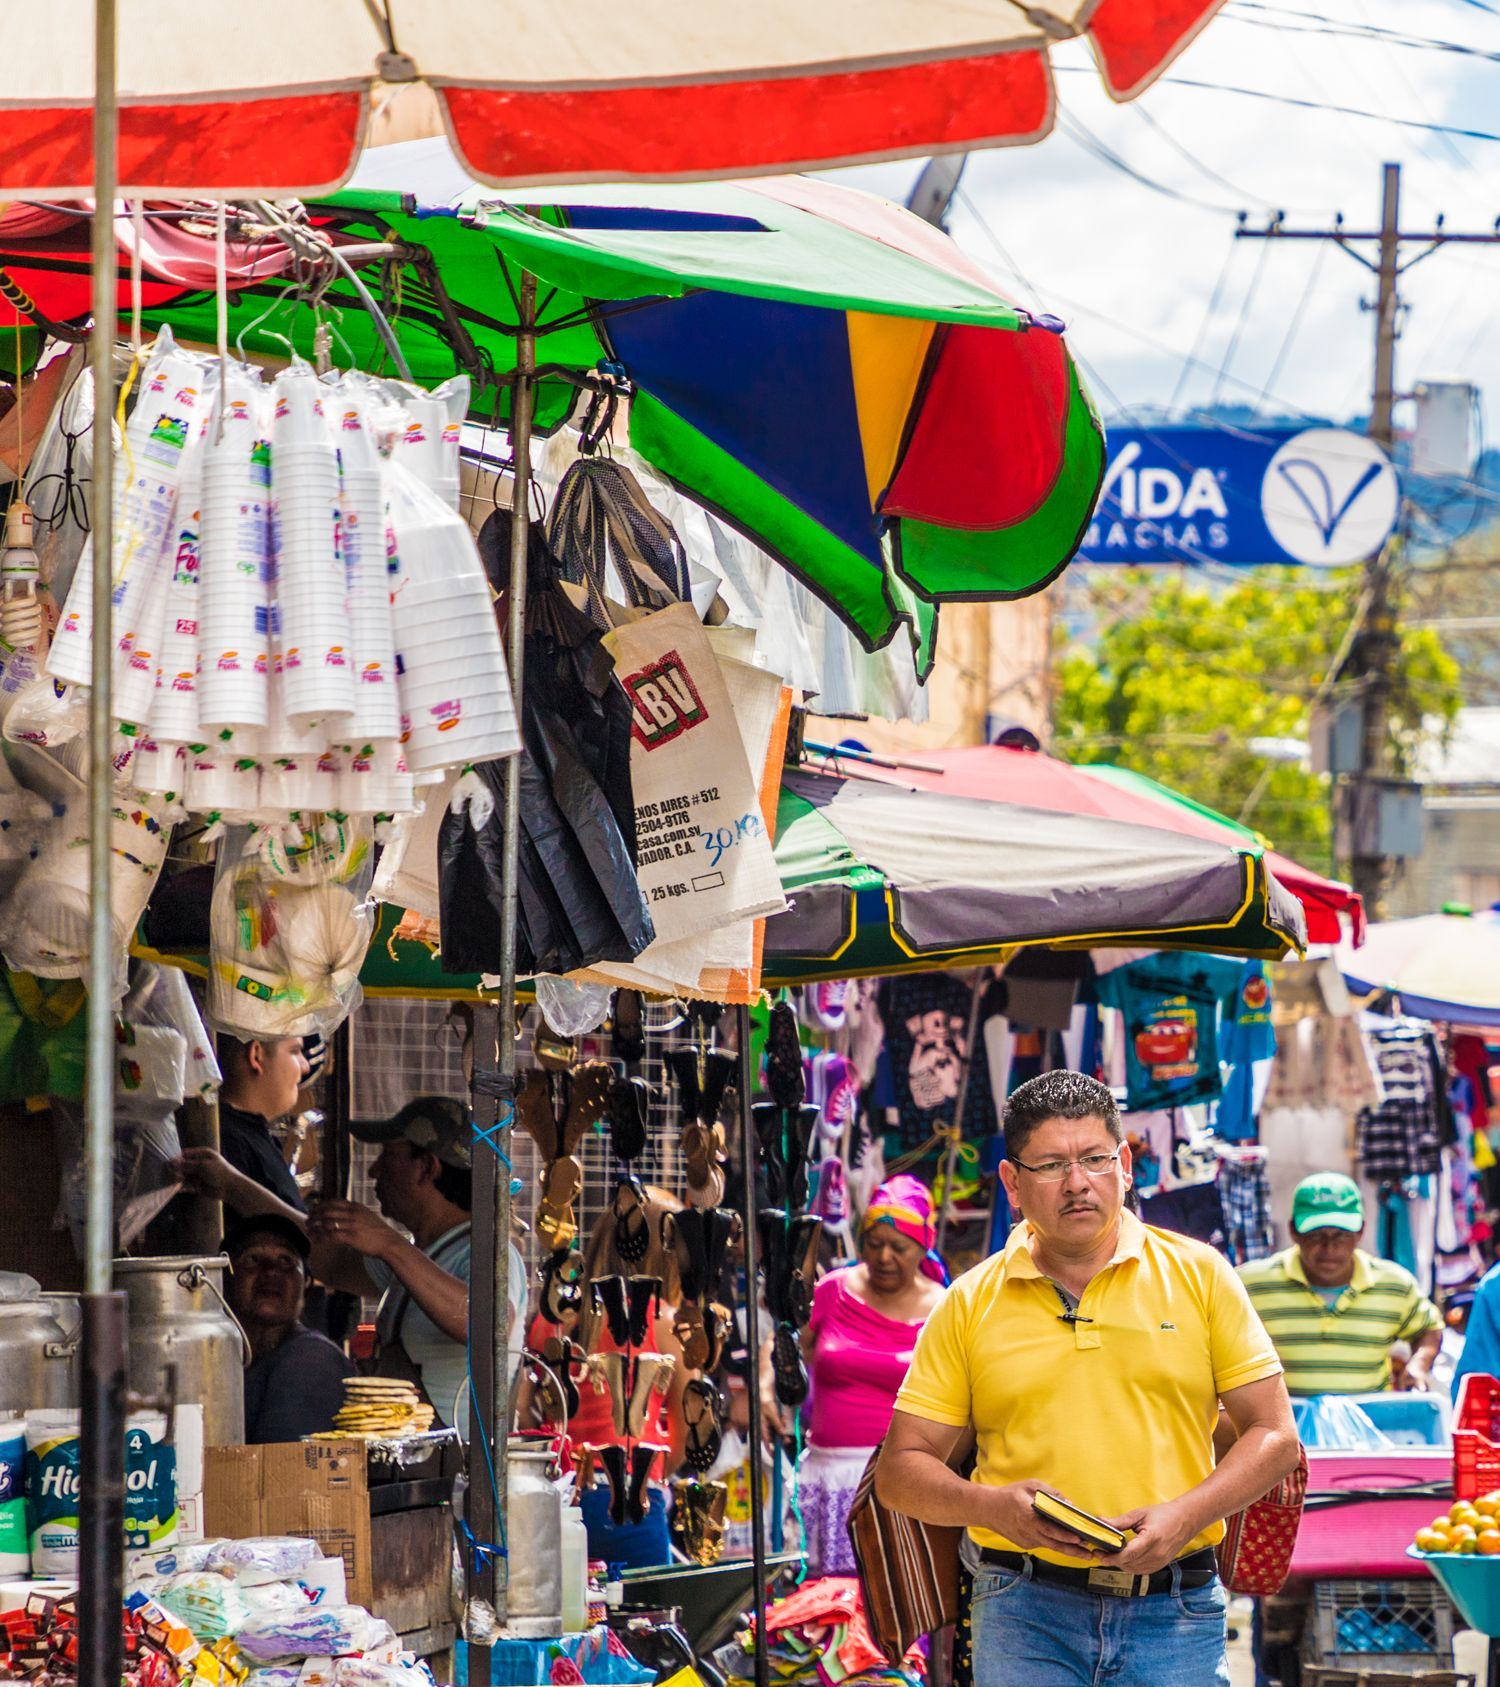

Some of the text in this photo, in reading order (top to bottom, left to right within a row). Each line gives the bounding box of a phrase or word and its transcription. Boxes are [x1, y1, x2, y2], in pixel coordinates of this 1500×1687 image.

[177, 621, 195, 633] 25
[660, 795, 690, 813] AIRES
[635, 811, 690, 835] 2504-9176
[637, 825, 701, 851] casa.com.sv
[636, 841, 696, 868] VADOR. C.A.
[651, 882, 690, 901] 25 kgs.
[129, 1435, 142, 1449] 4
